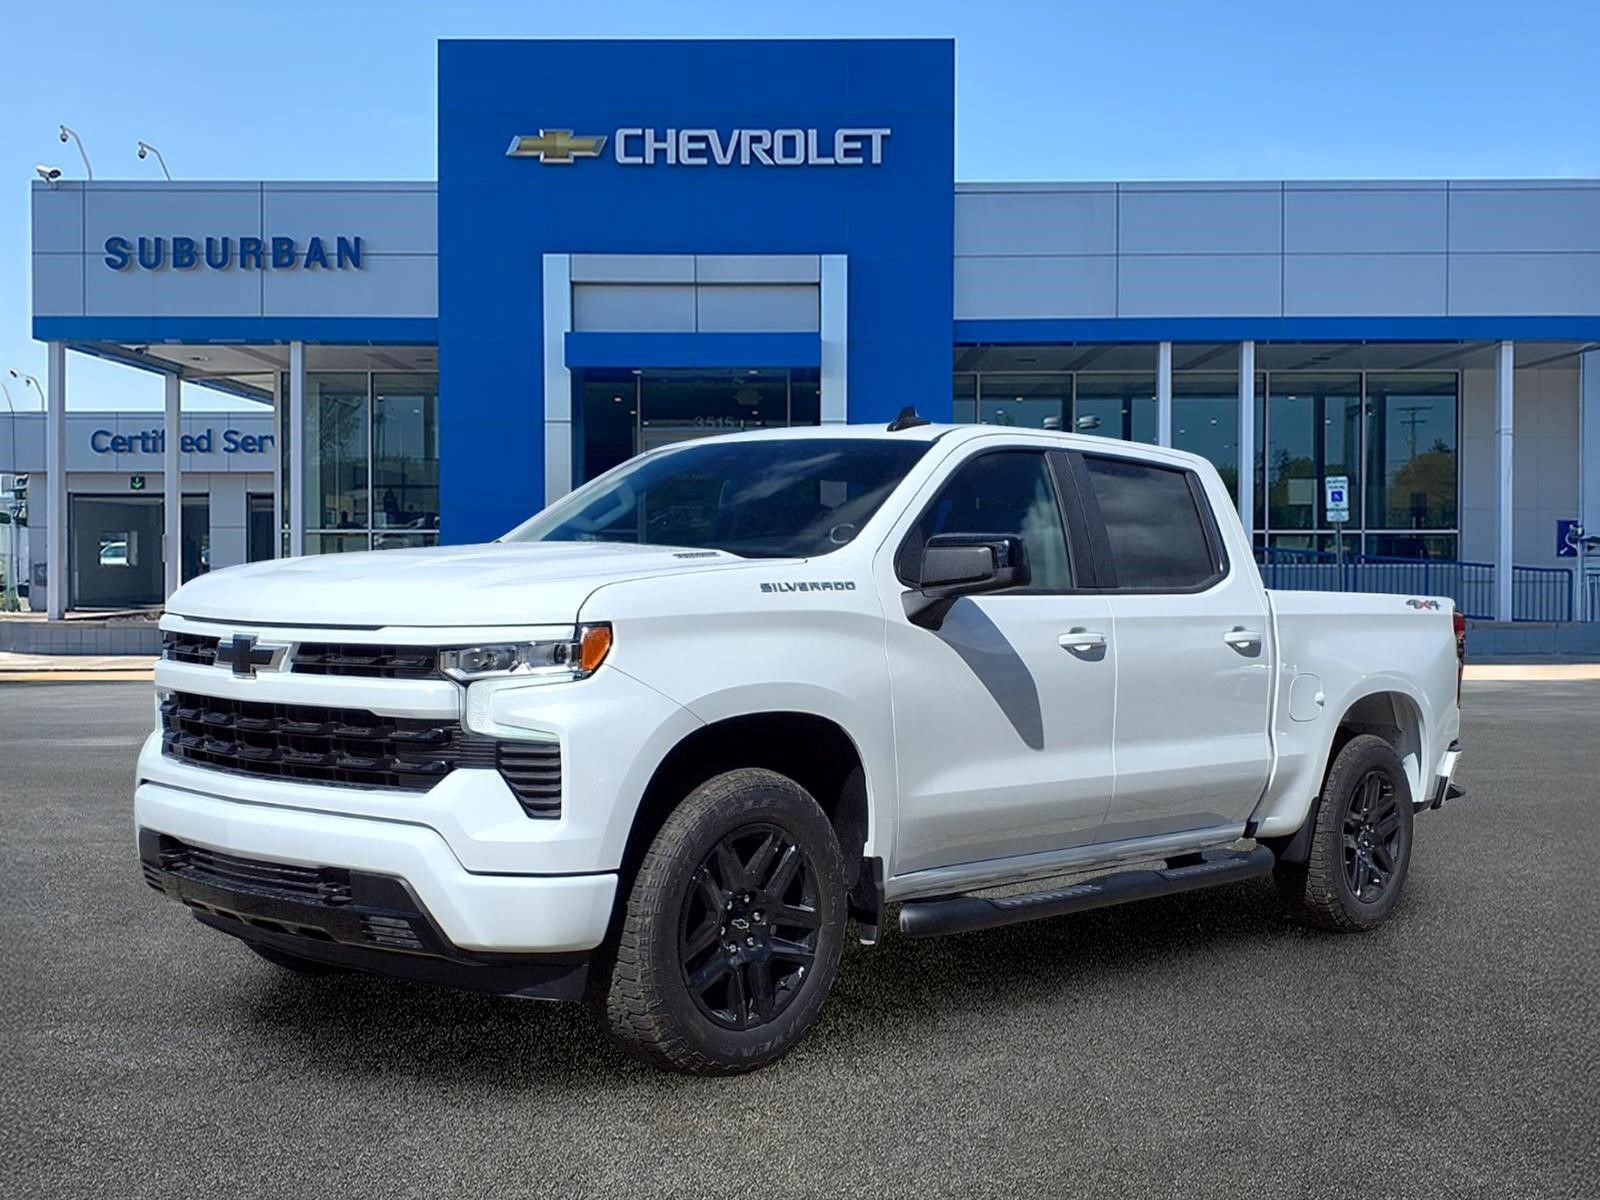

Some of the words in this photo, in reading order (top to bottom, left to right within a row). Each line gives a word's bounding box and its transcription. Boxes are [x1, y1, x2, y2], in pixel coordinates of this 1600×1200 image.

[615, 128, 891, 165] CHEVROLET
[104, 236, 362, 270] SUBURBAN
[760, 581, 856, 593] SILVERADO
